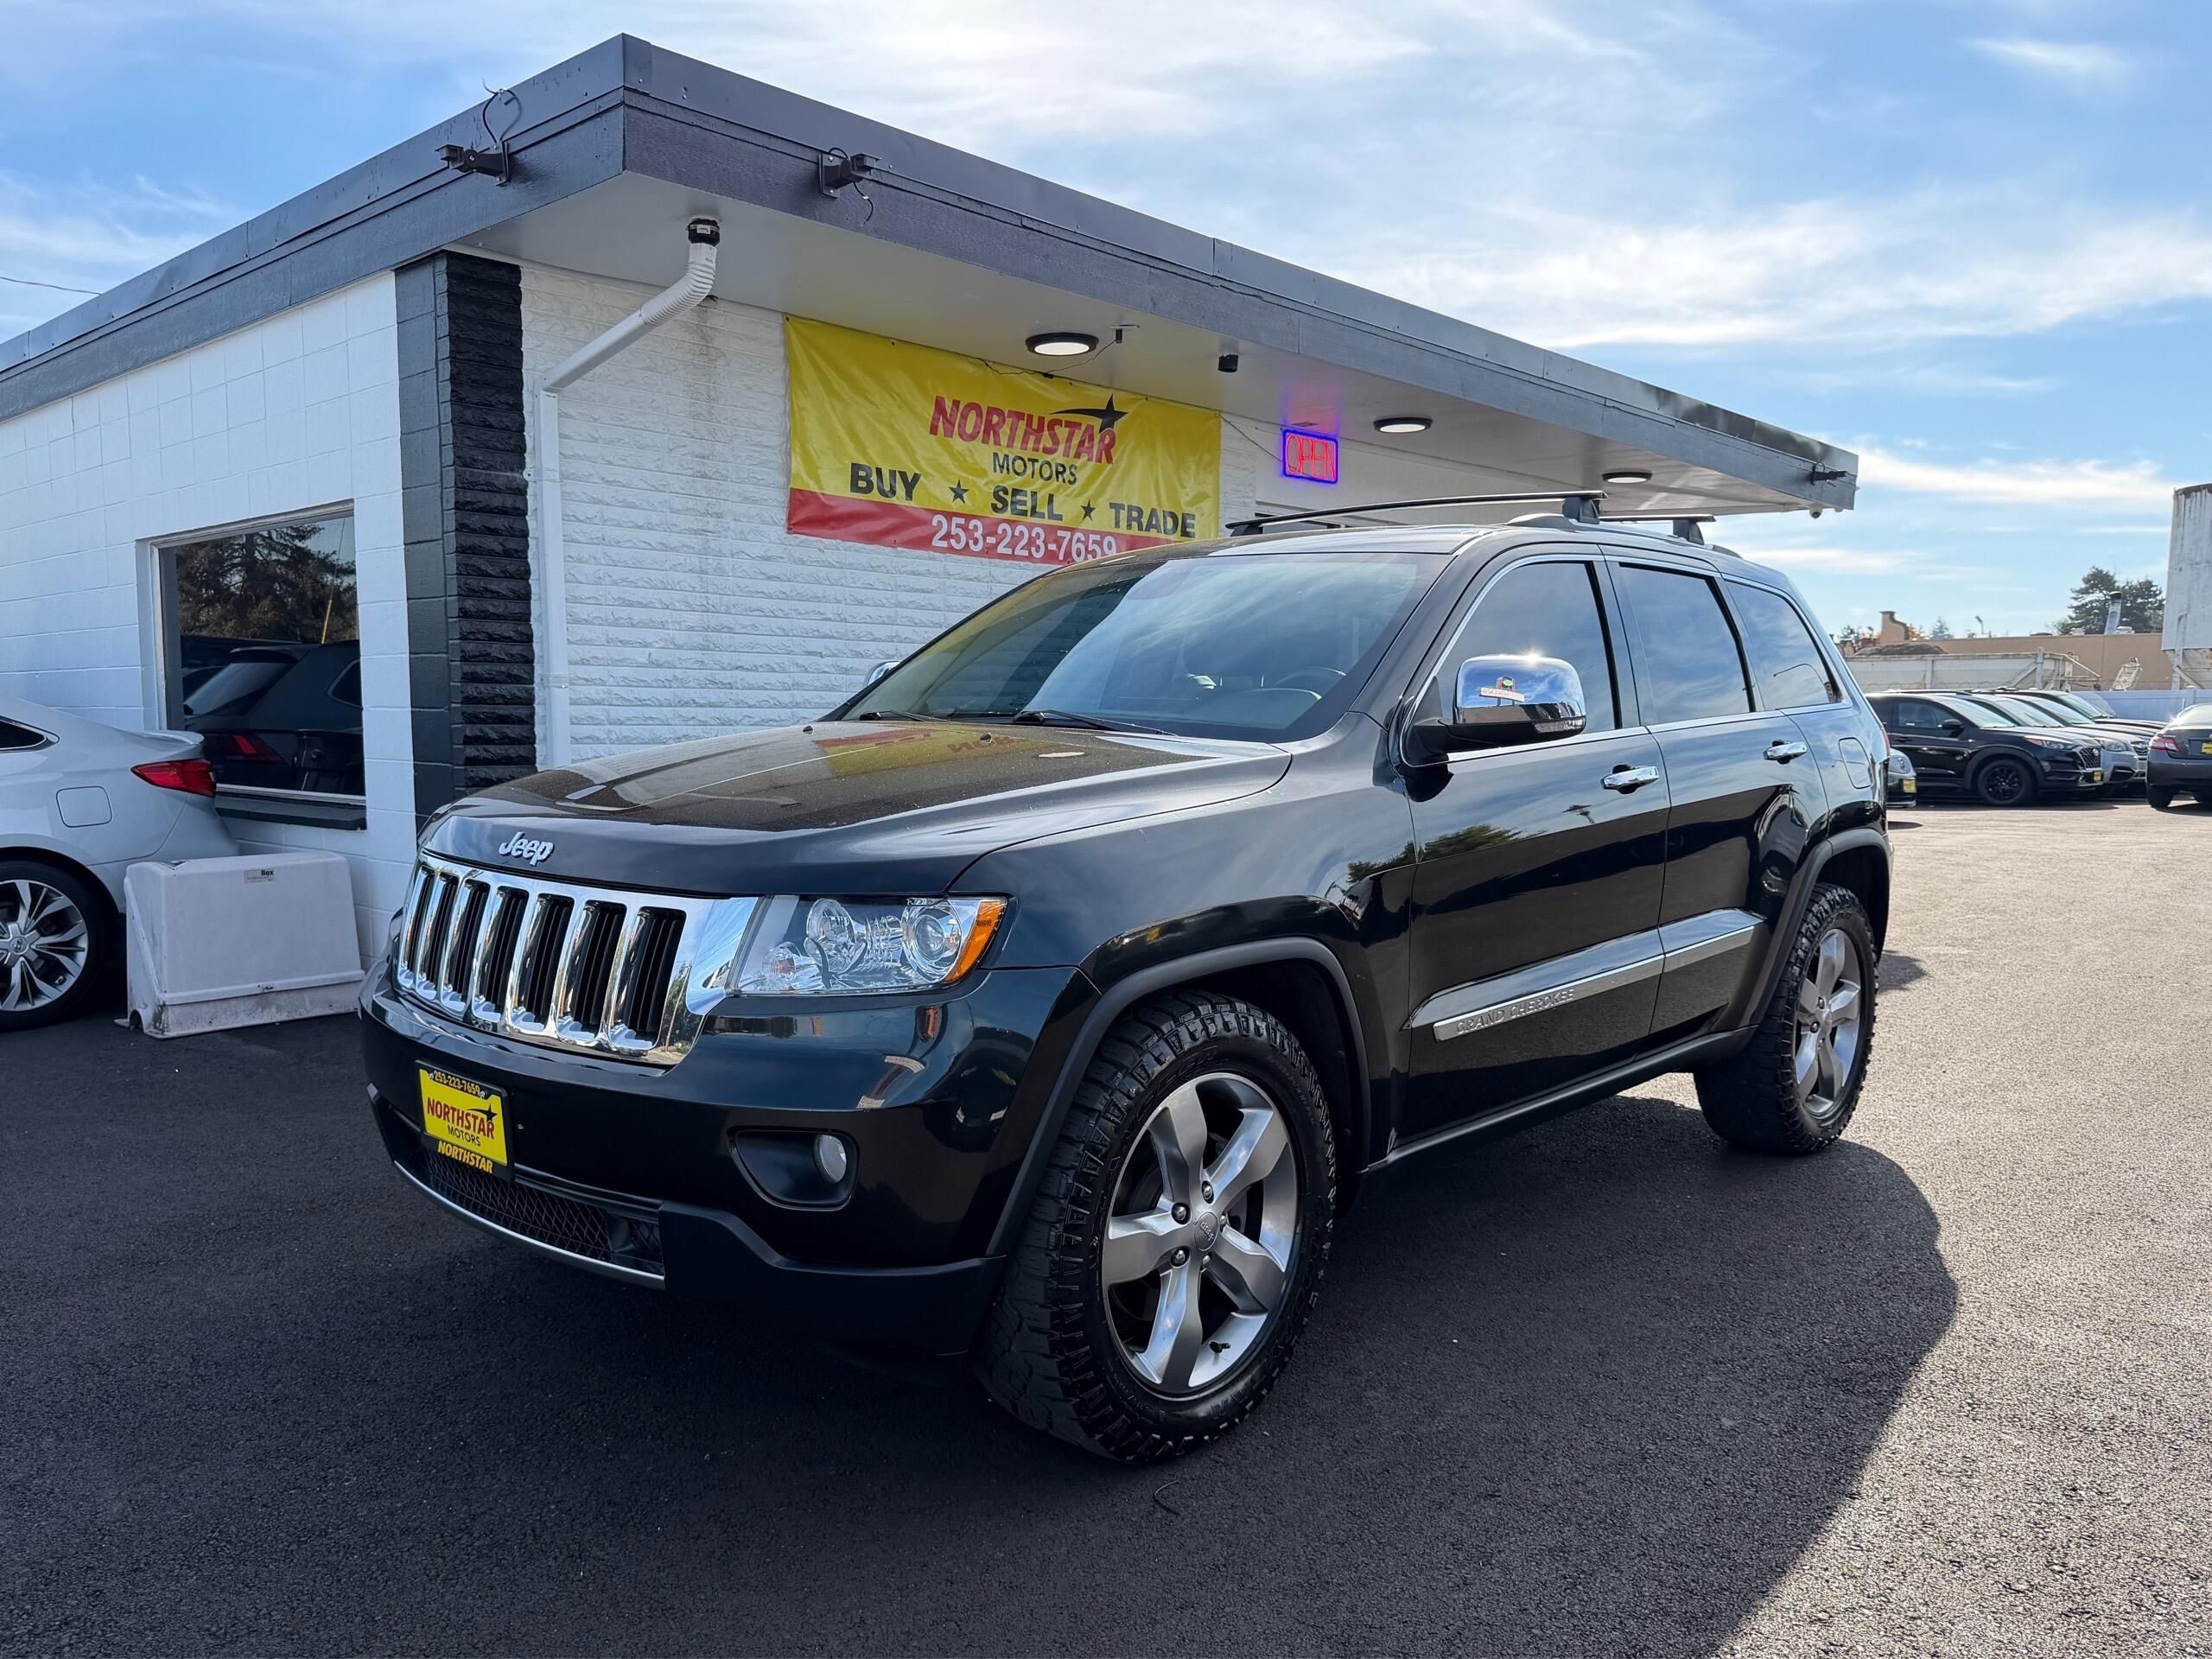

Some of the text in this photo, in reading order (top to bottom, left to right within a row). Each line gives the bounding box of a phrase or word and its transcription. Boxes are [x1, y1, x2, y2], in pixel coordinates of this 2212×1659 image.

[929, 395, 1117, 465] NORTHSTAR
[993, 452, 1077, 486] MOTORS
[1285, 434, 1336, 480] OPEN
[849, 462, 1196, 539] BUY SELL TRADE
[931, 514, 1117, 563] 253-223-7659
[499, 831, 554, 866] Jeep
[1457, 988, 1575, 1035] GRAND CHEROKEE
[433, 1071, 480, 1095] 253-223-7659
[427, 1096, 495, 1140] NORTHSTAR
[448, 1125, 481, 1147] MOTORS
[437, 1141, 493, 1173] NORTHSTAR
